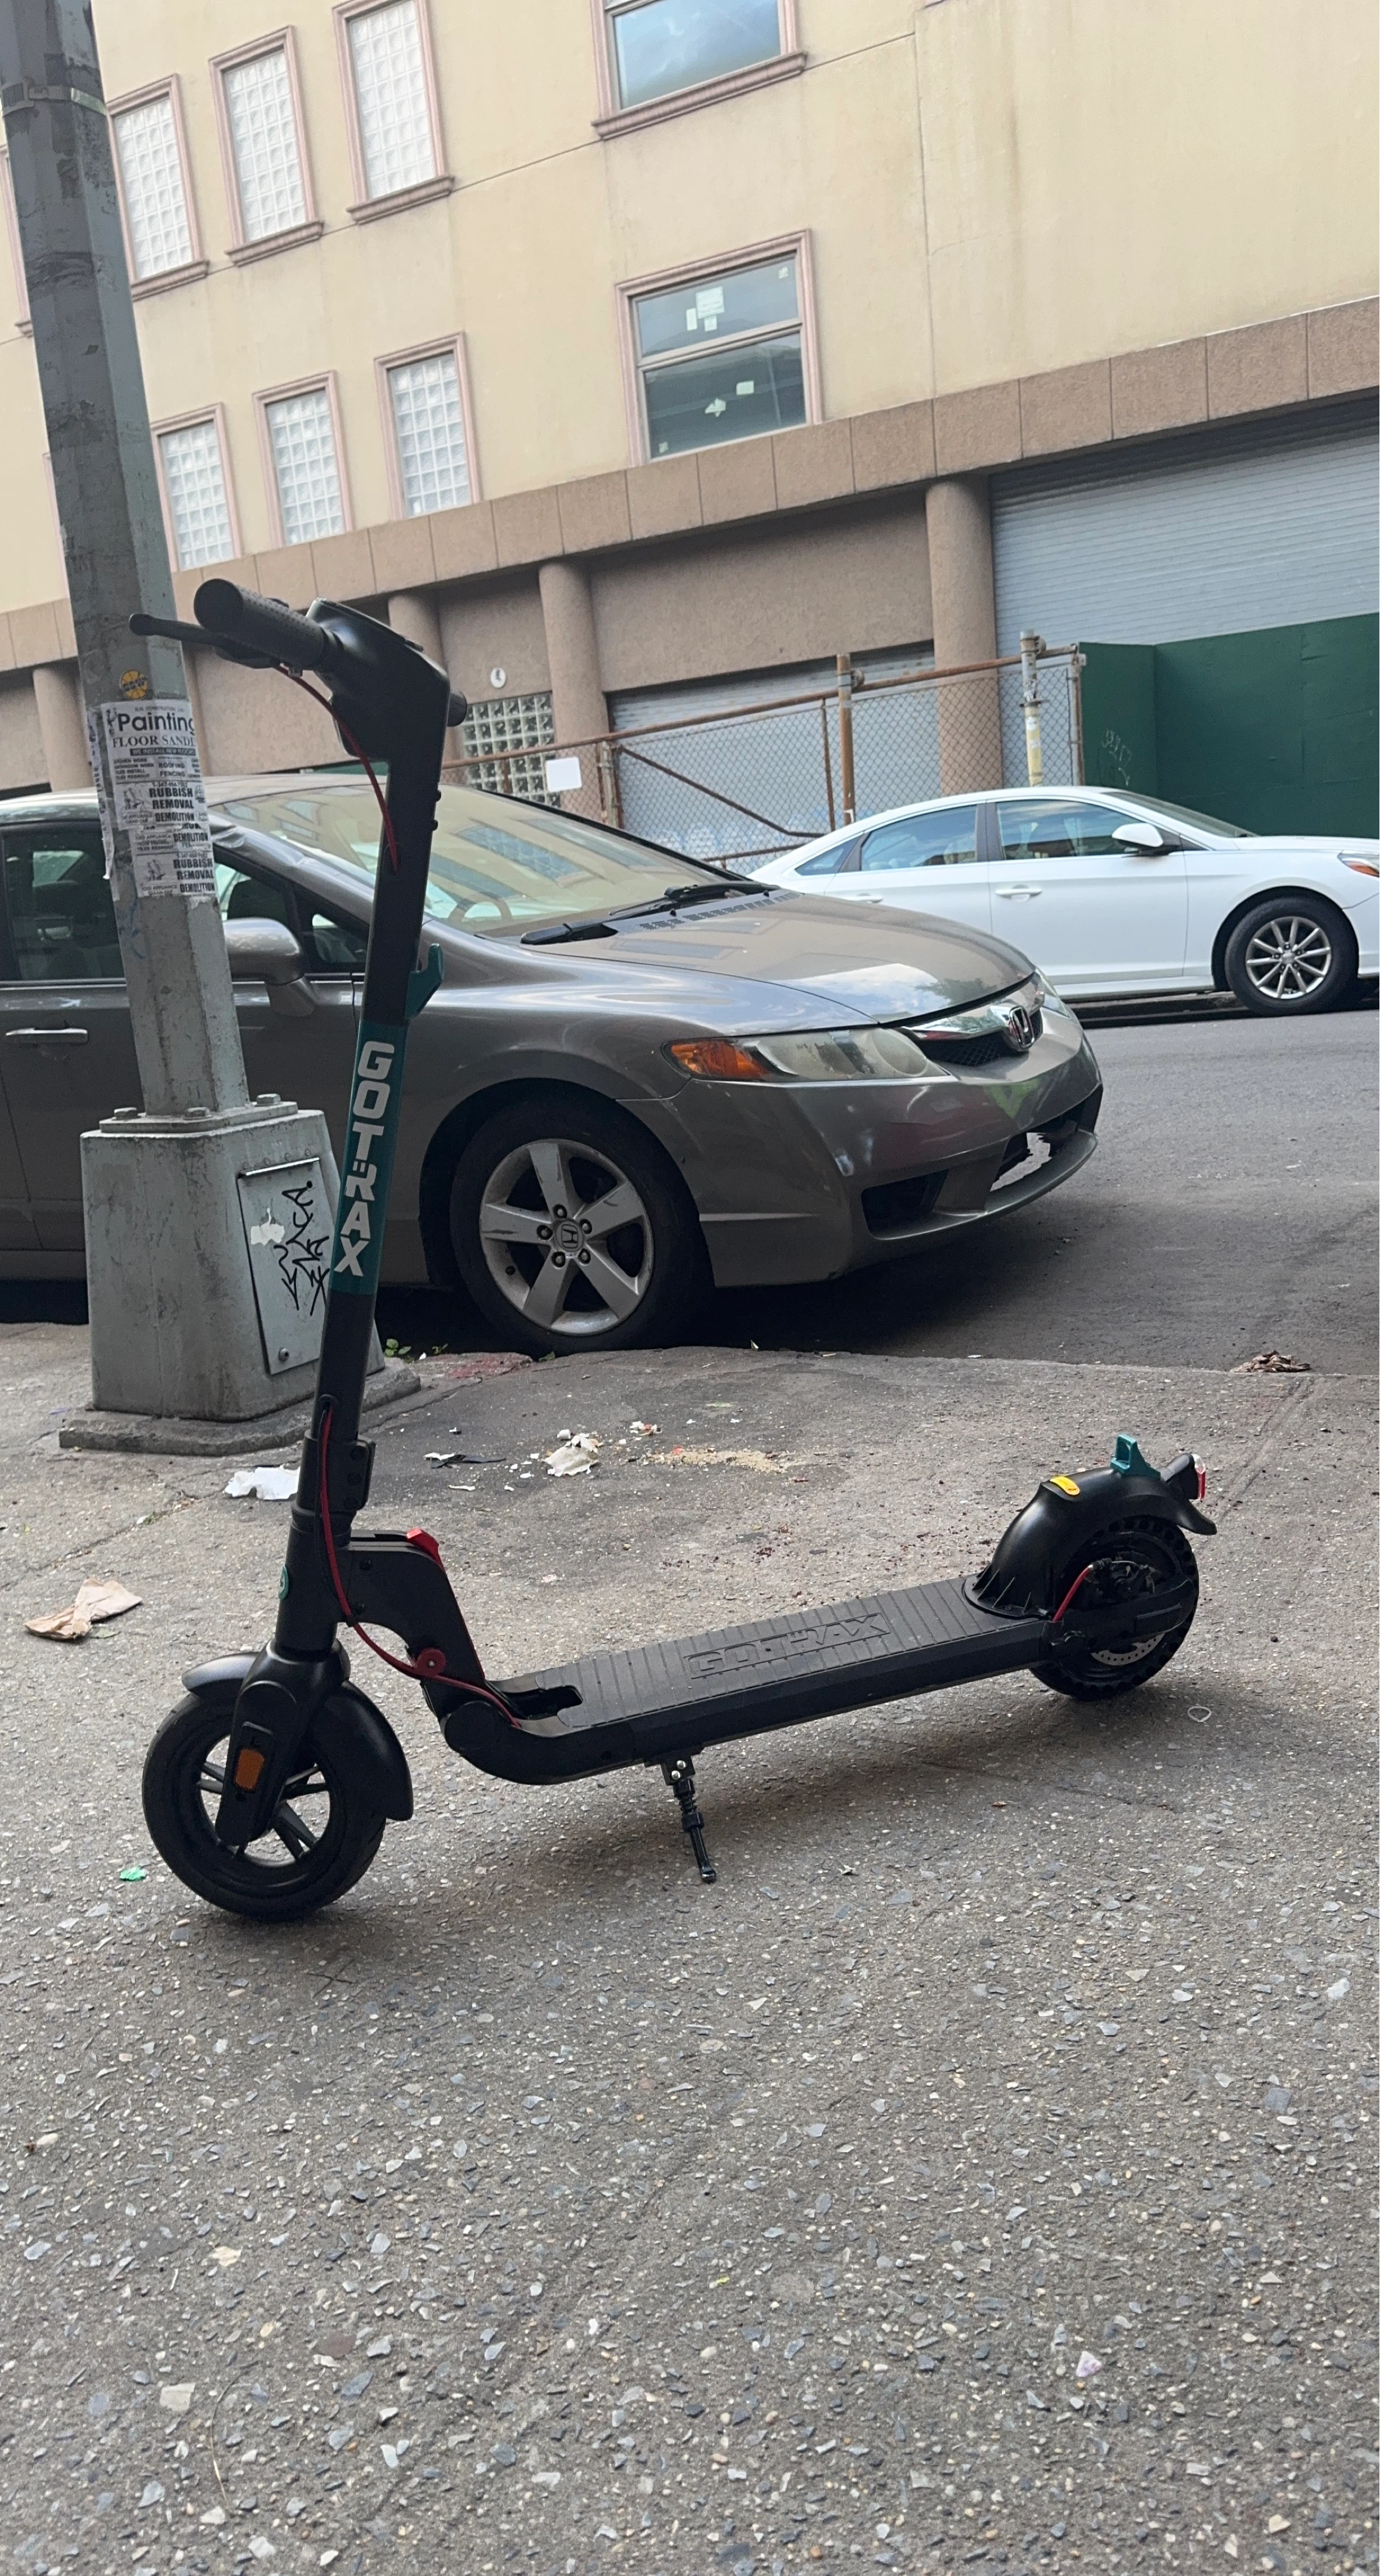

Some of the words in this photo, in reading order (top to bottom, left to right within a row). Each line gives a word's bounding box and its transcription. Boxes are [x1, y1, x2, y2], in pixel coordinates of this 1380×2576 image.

[113, 735, 159, 748] FLOOR
[149, 787, 193, 798] RUBBISH
[152, 799, 194, 810] REMOVAL
[155, 812, 195, 822] DEMOLITION
[173, 832, 209, 843] DEMOLITION
[173, 858, 213, 869] RUBBISH
[176, 869, 215, 880] REMOVAL
[179, 882, 215, 893] DEMOLITION
[333, 1040, 395, 1277] GOTRAX
[688, 1612, 888, 1672] GOTRAX
